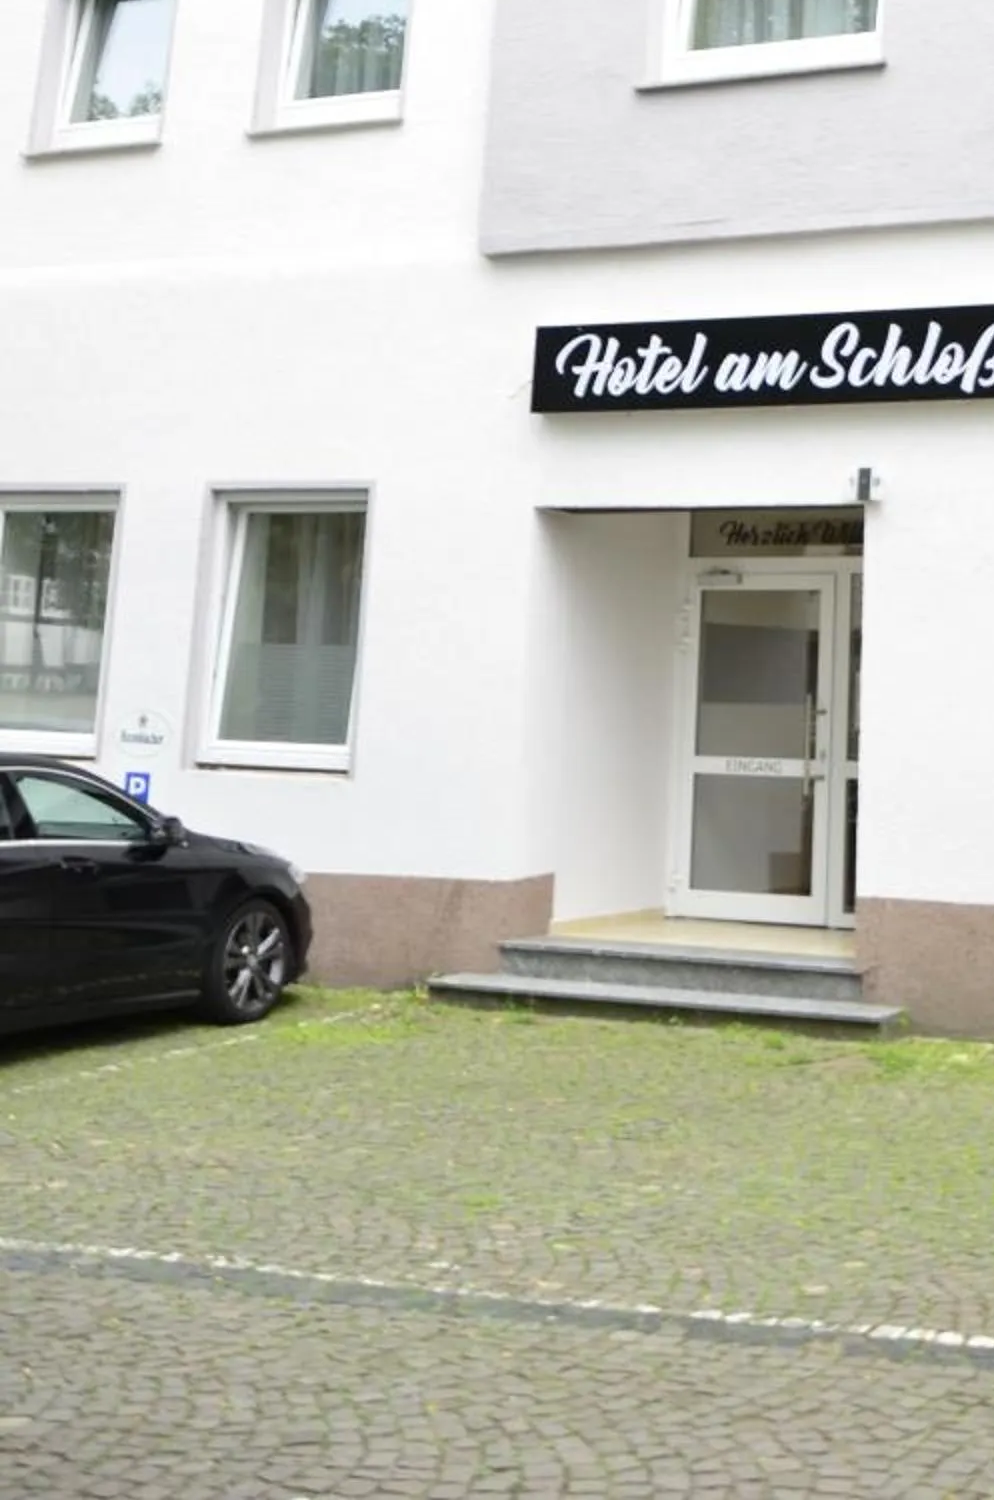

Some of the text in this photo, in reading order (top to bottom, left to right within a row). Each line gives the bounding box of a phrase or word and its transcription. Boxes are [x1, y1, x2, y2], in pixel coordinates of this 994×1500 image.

[556, 333, 707, 397] Hotel
[714, 350, 805, 393] am
[726, 758, 782, 773] EINGANG
